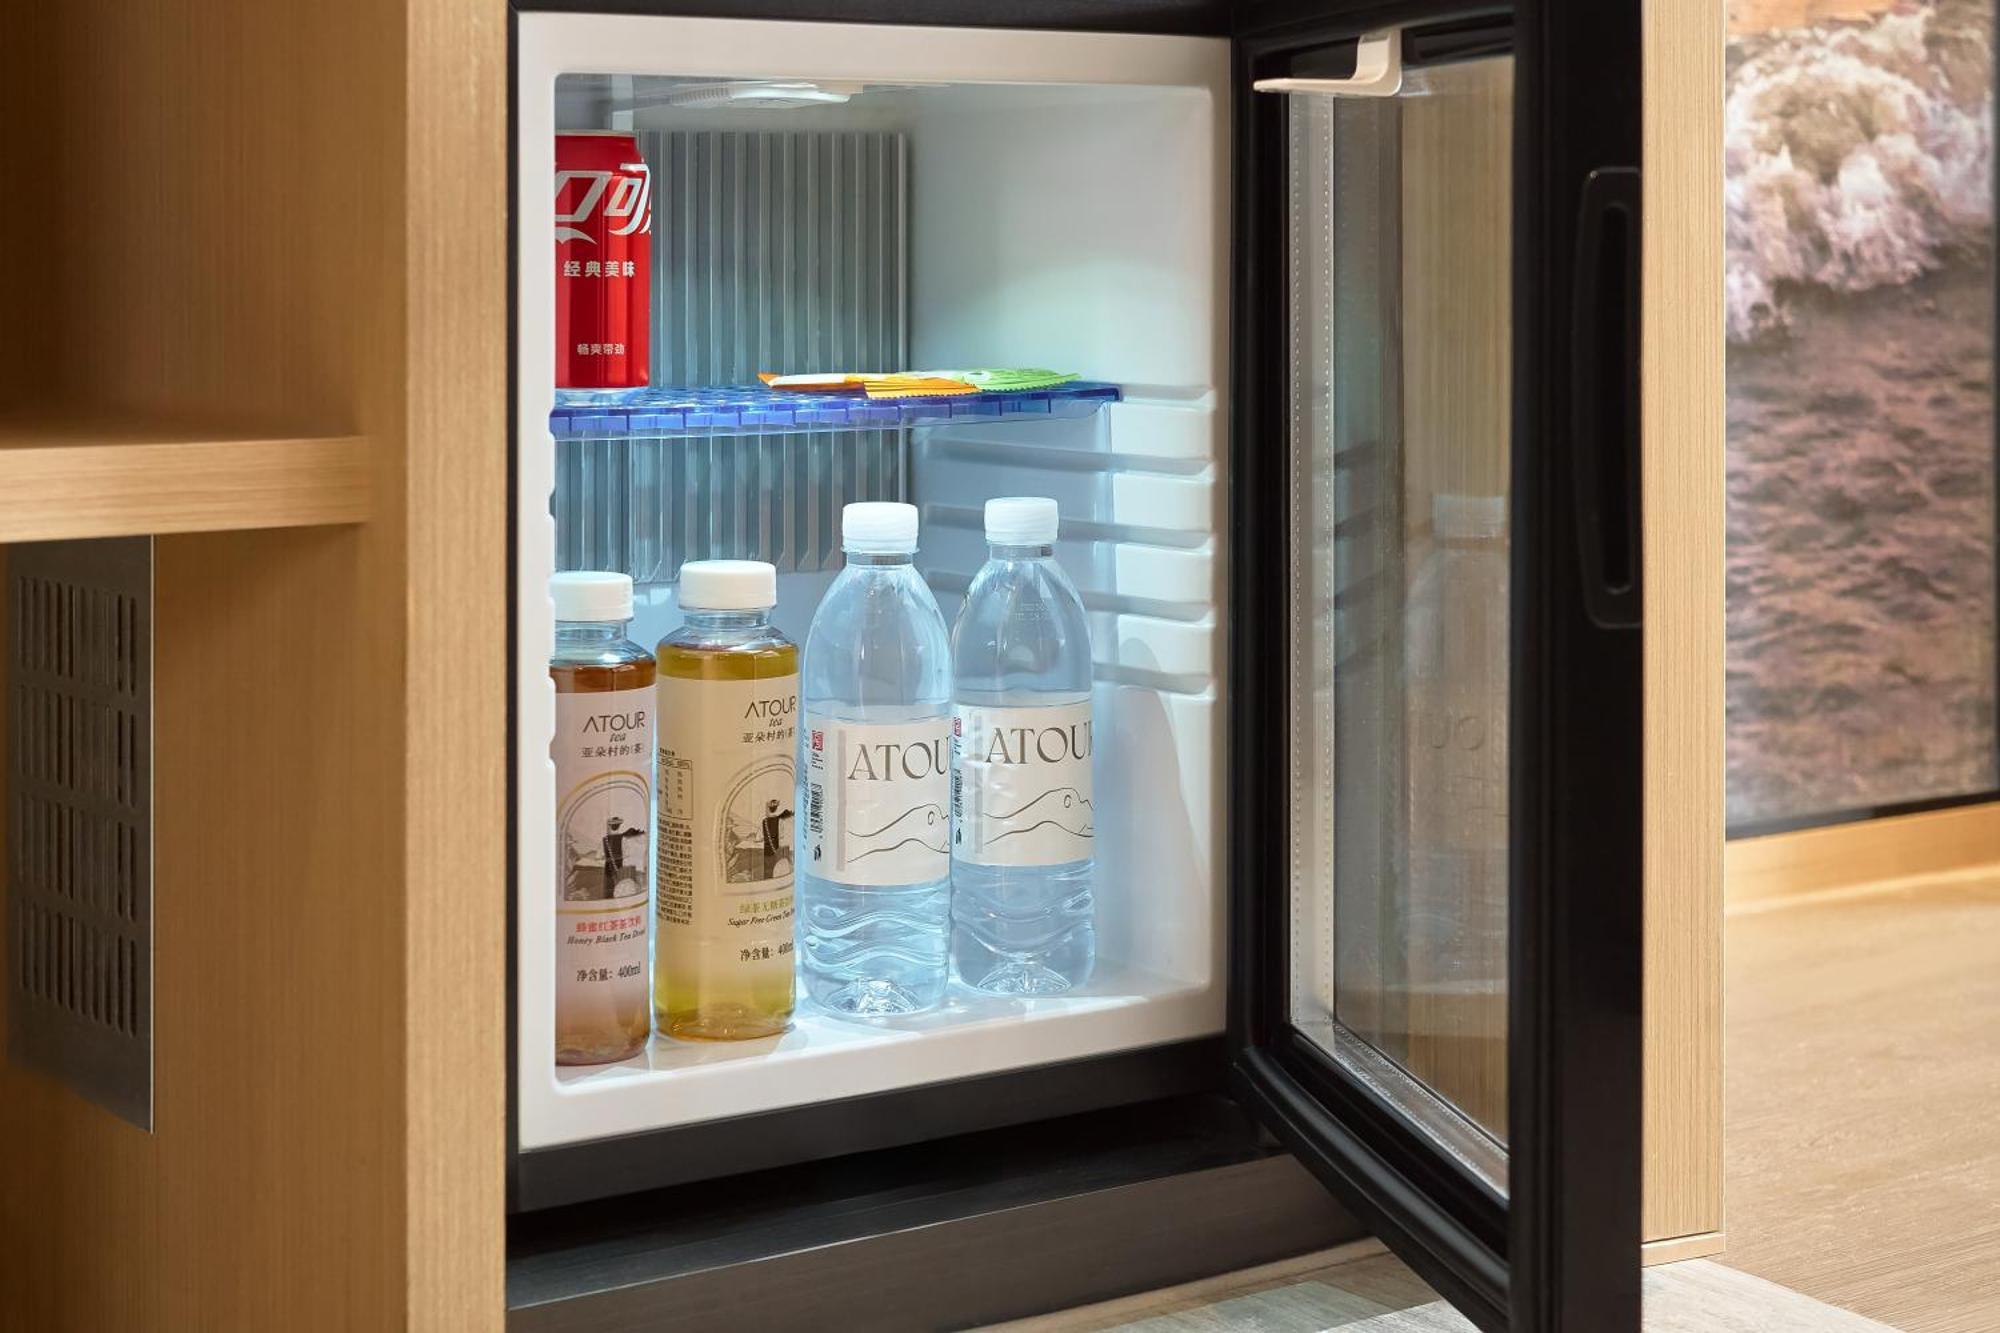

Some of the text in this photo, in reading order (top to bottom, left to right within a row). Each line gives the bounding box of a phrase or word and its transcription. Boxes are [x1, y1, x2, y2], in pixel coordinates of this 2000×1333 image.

[563, 260, 635, 278] 经典美味
[576, 343, 625, 355] 畅爽带劲
[744, 695, 796, 719] ATOUR
[583, 711, 645, 733] ATOUR
[567, 935, 594, 945] Honey
[595, 934, 617, 944] Black
[619, 932, 631, 941] Tea
[617, 961, 641, 977] 400ml
